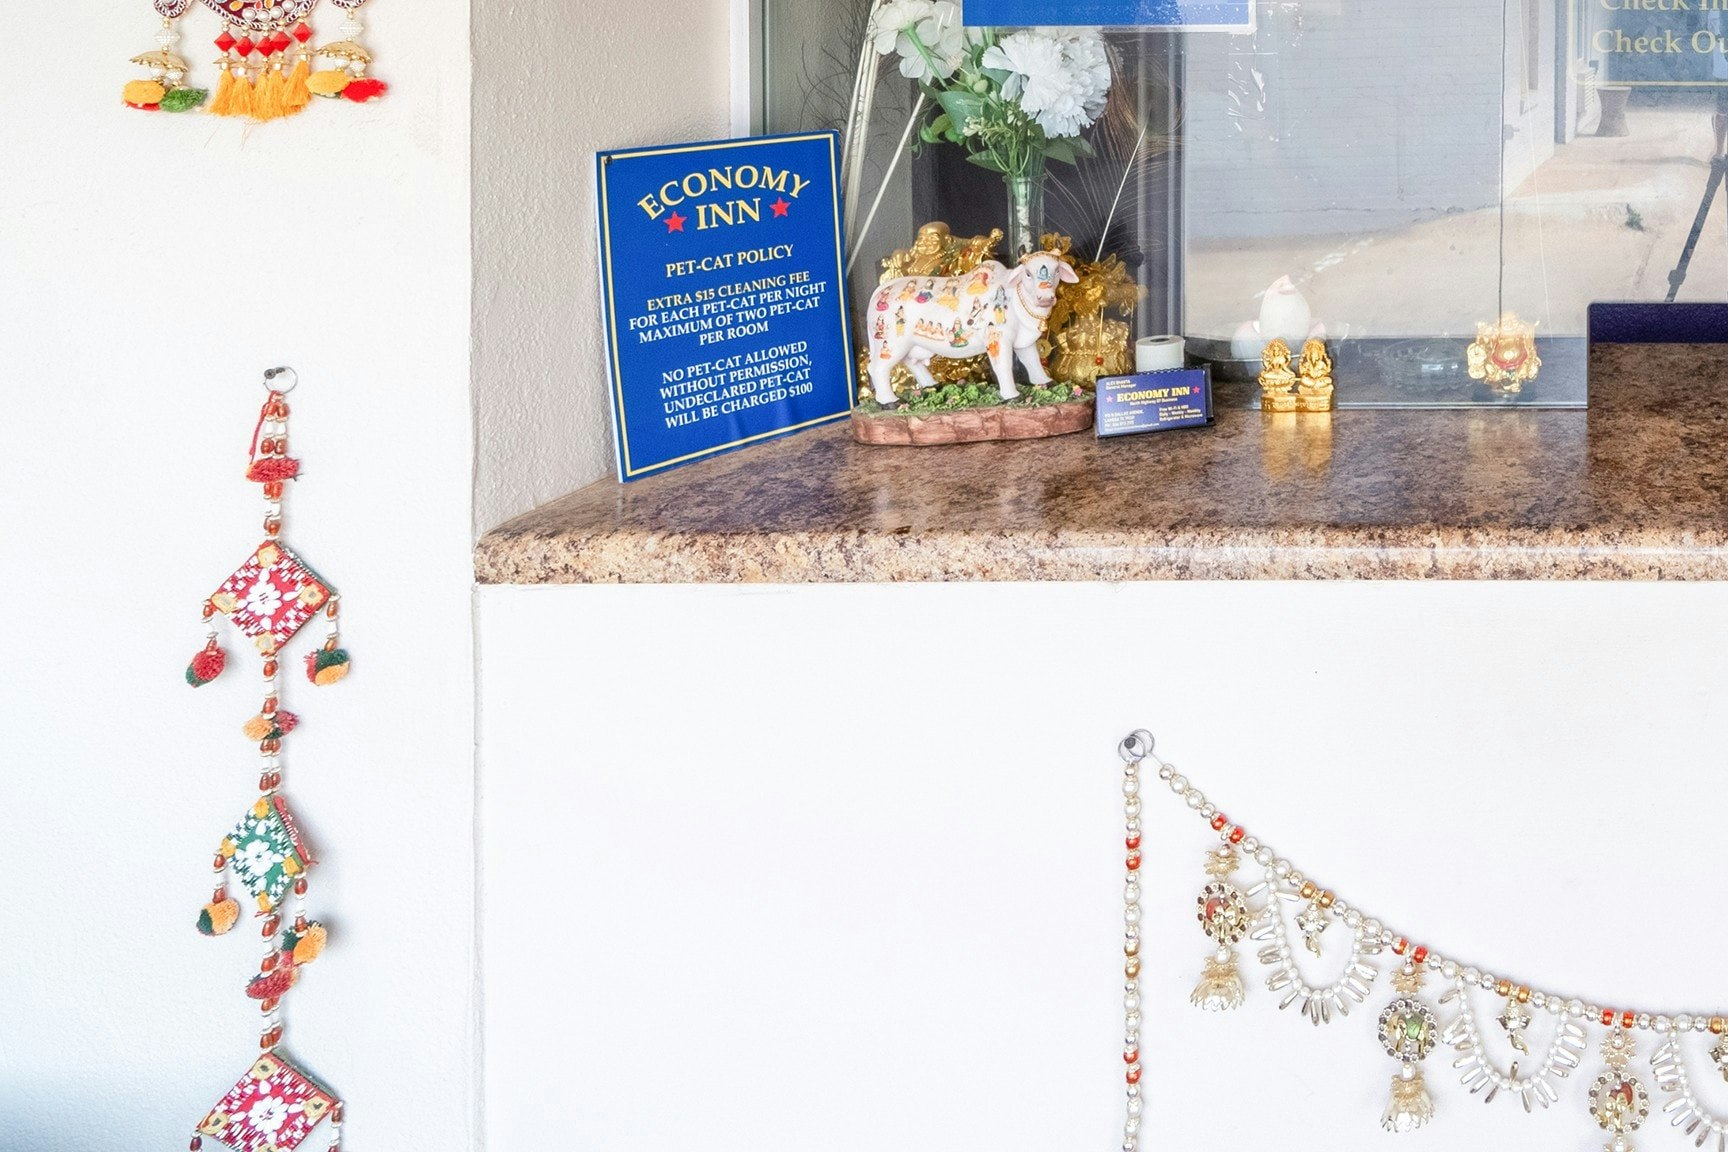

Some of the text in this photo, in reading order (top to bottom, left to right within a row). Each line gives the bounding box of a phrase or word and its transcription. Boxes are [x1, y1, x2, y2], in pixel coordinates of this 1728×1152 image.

[1592, 30, 1682, 54] Check
[638, 165, 811, 220] ECONOMY
[696, 198, 761, 230] INN
[666, 244, 792, 277] PET-CAT POLICY
[629, 281, 825, 329] FOR EACH PET-CAT PER NIGHT
[647, 271, 809, 310] EXTRA $15 CLEANING FEE
[639, 296, 819, 342] MAXIMUM OF TWO PET-CAT
[699, 320, 768, 345] PER ROOM
[659, 354, 811, 398] WITHOUT PERMISSION,
[662, 341, 806, 383] NO PET-CAT ALLOWED
[664, 368, 810, 413] UNDECLARED PET-CAT
[665, 382, 812, 427] WILL BE CHARGED $100
[1116, 386, 1190, 402] ECONOMY INN
